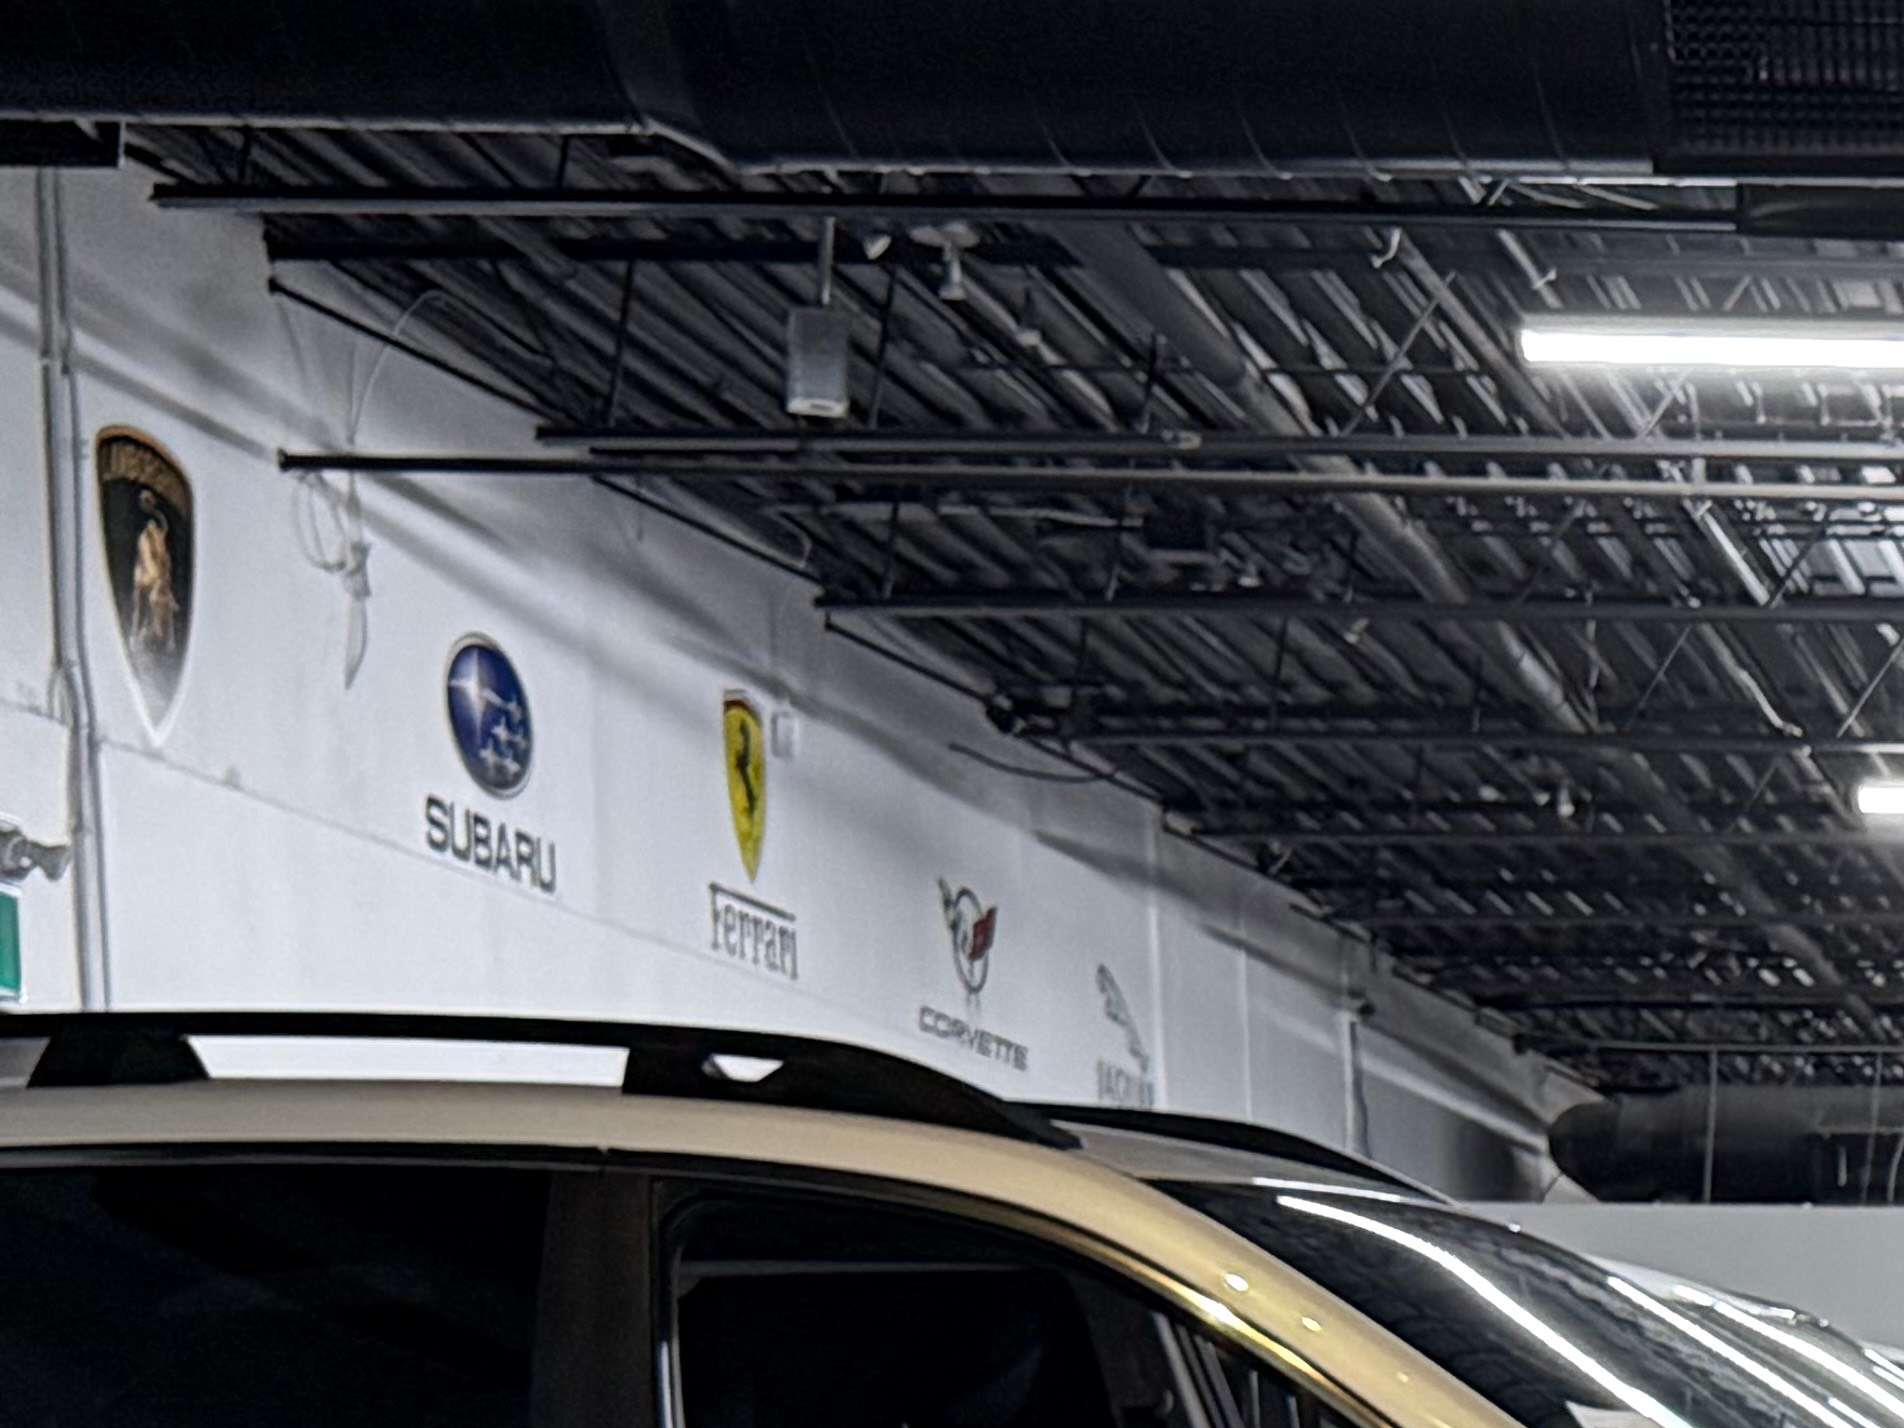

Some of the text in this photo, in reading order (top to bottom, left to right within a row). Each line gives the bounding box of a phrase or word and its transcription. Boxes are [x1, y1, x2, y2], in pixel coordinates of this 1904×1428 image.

[425, 794, 556, 893] SUBARU
[708, 882, 798, 980] Ferrari
[919, 1005, 1029, 1072] CORVETTE
